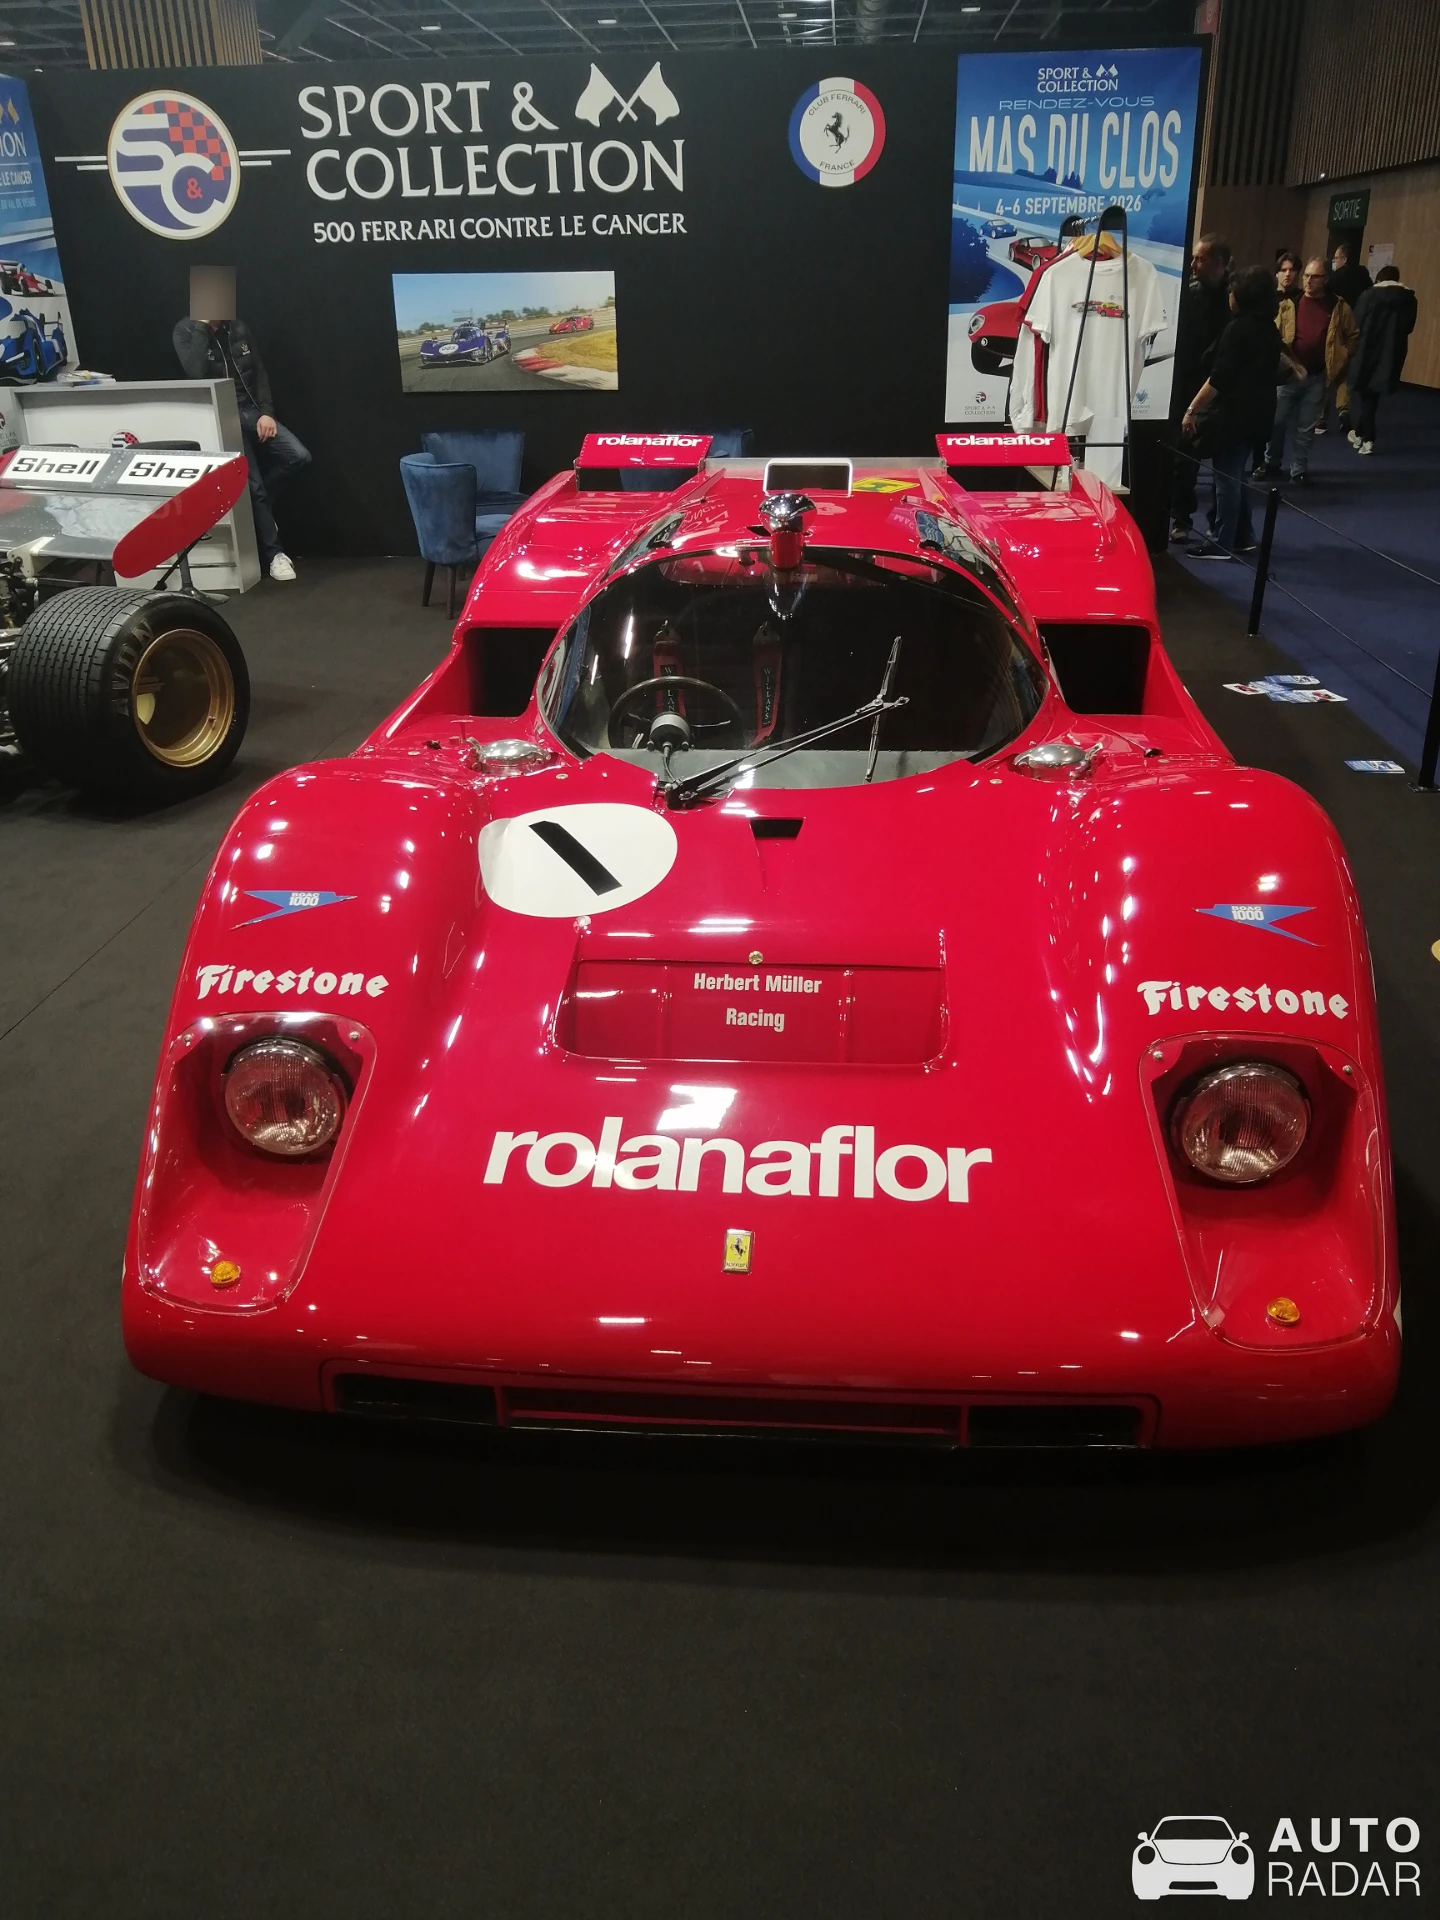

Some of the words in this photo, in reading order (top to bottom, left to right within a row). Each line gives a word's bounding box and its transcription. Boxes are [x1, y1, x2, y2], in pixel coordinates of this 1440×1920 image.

[1037, 67, 1079, 80] SPORT
[1082, 67, 1092, 79] &
[1037, 79, 1119, 93] COLLECTION
[298, 81, 491, 139] SPORT
[511, 81, 560, 132] &
[808, 97, 829, 116] CLUB
[830, 93, 867, 115] FERRARI
[999, 96, 1155, 111] RENDEZ-VOUS
[969, 114, 1037, 174] MAS
[1048, 112, 1090, 185] DU
[1099, 109, 1182, 190] CLOS
[306, 139, 686, 201] COLLECTION
[819, 159, 856, 171] FRANCE
[995, 198, 1021, 215] 4-6
[1024, 195, 1106, 215] SEPTEMBRE
[1109, 194, 1142, 212] 2026
[1333, 198, 1362, 221] SORTIE
[313, 221, 355, 243] 500
[361, 218, 456, 242] FERRARI
[460, 215, 554, 240] CONTRE
[560, 214, 586, 236] LE
[592, 212, 688, 236] CANCER
[597, 434, 703, 447] rolanaflor
[946, 434, 1055, 446] rolanaflor
[12, 457, 100, 475] Shell
[128, 461, 223, 479] Shel
[528, 820, 622, 896] 1
[289, 896, 320, 907] 1000
[1231, 910, 1265, 921] 1000
[196, 964, 390, 1000] Firestone
[693, 972, 760, 991] Herbert
[765, 975, 823, 993] Müller
[1137, 980, 1349, 1020] Firestone
[726, 1007, 785, 1033] Racing
[483, 1117, 993, 1203] rolanaflor
